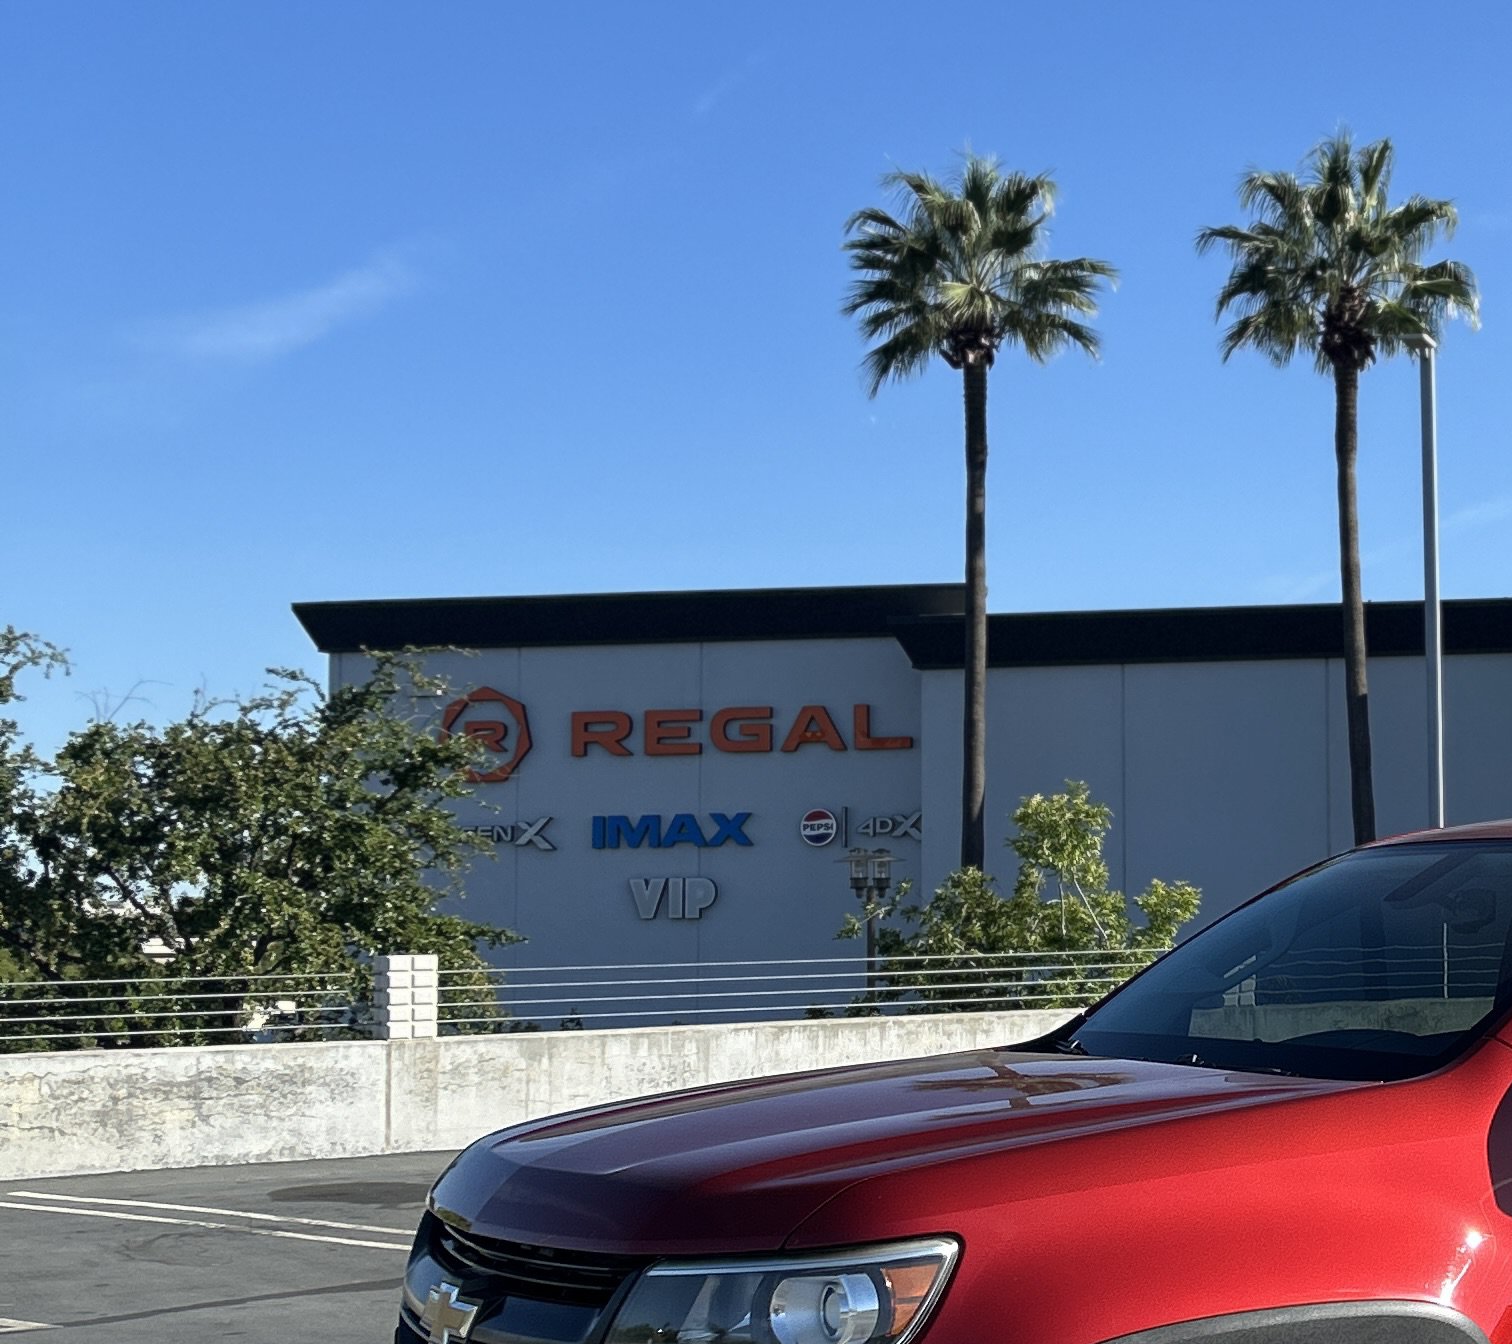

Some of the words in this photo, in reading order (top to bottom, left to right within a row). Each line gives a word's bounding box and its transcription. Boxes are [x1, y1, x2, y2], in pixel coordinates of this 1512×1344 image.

[571, 704, 913, 757] REGAL
[592, 812, 753, 849] IMAX
[802, 822, 834, 832] PEPSI
[857, 811, 922, 840] 4DX
[630, 877, 718, 920] VIP
